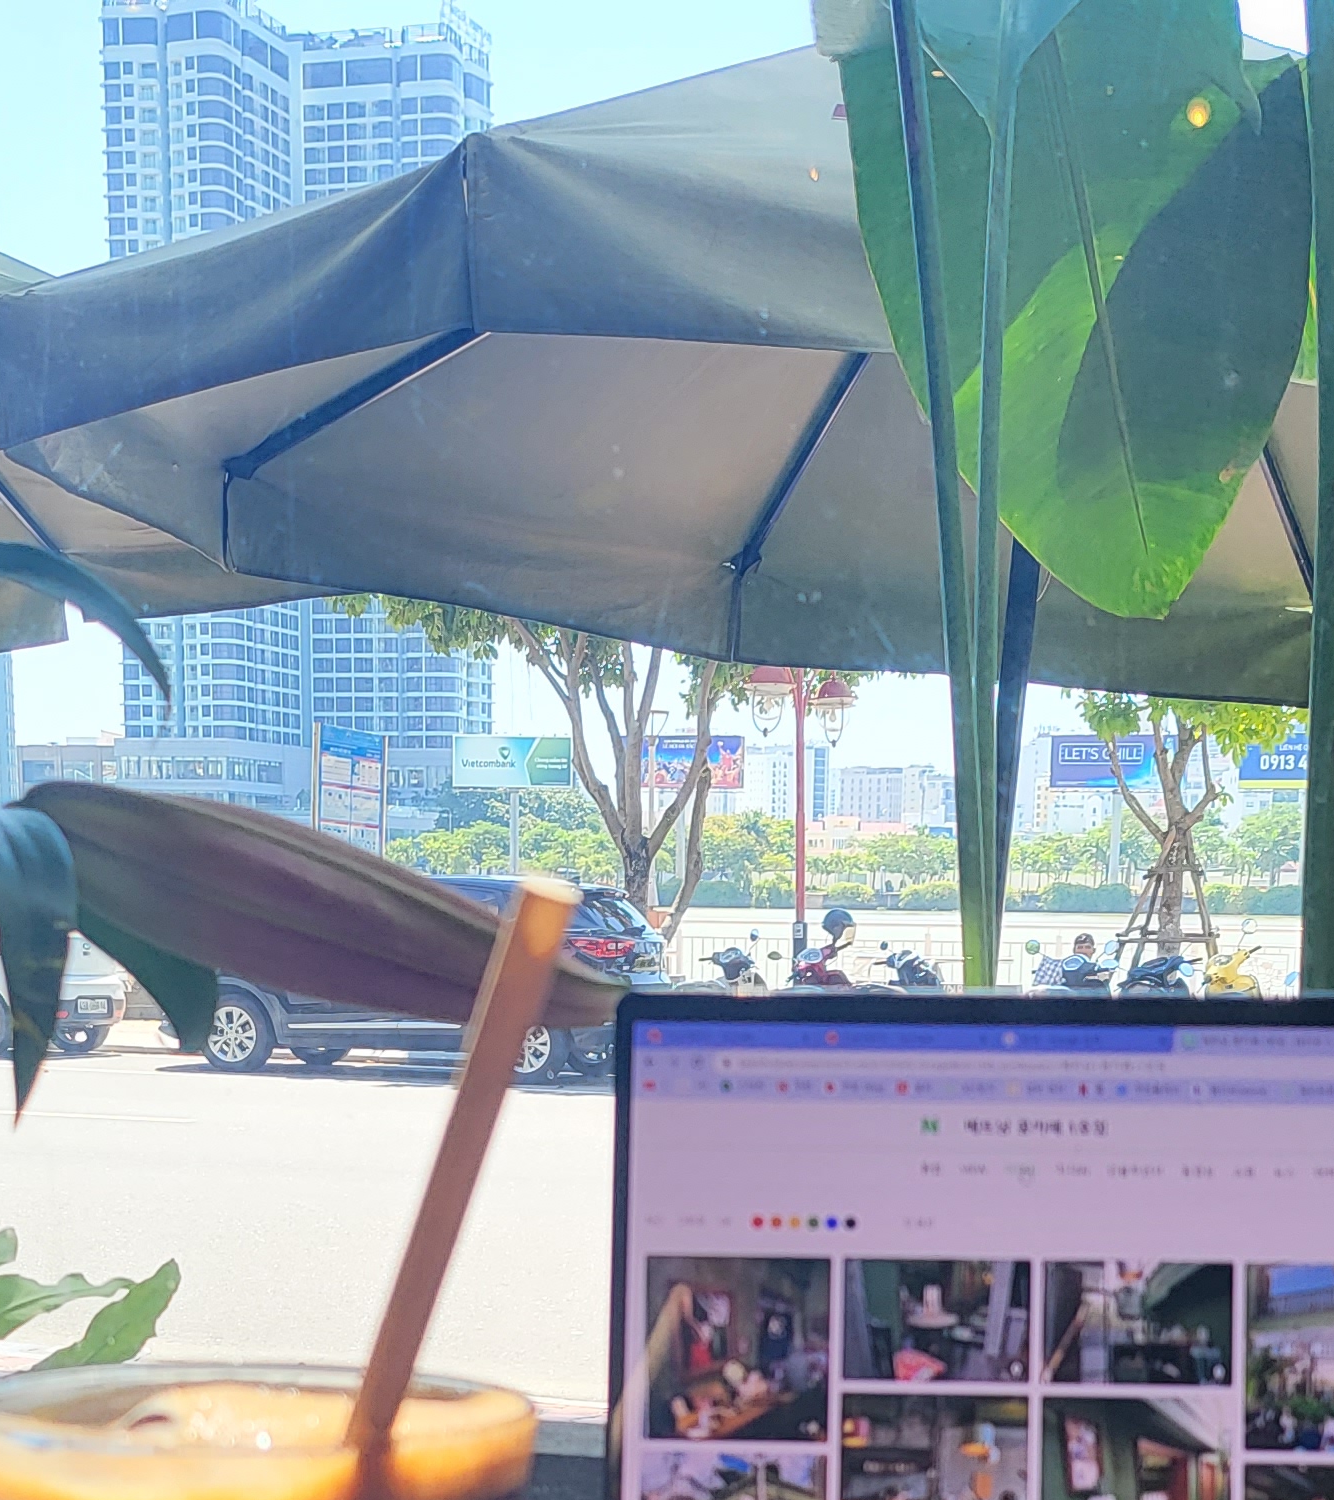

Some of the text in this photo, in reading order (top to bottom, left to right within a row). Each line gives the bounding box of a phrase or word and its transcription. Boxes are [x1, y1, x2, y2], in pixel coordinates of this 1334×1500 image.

[1064, 747, 1099, 760] LET'S
[461, 759, 517, 768] Vietcombank
[1260, 754, 1295, 770] 0913
